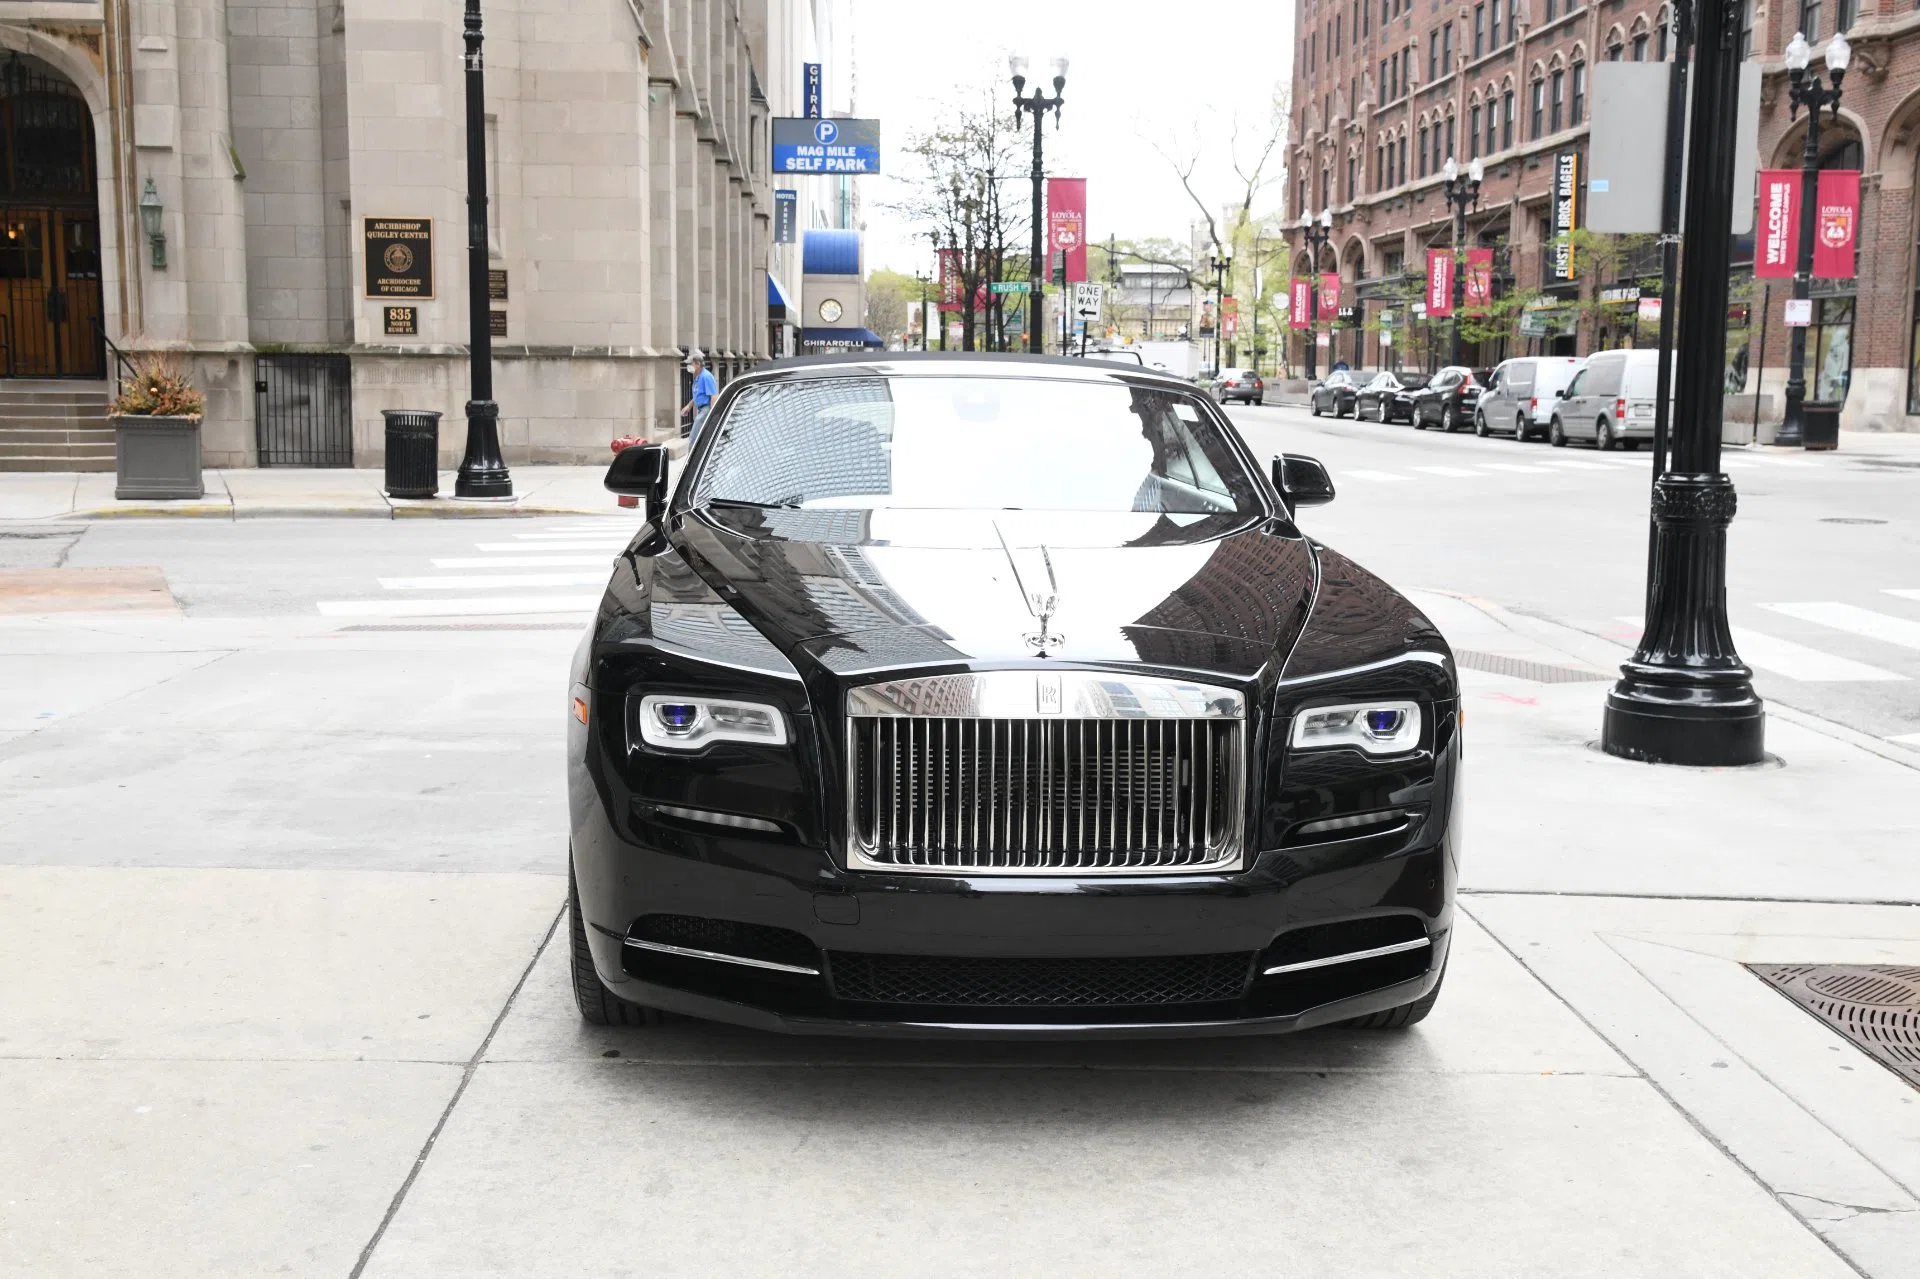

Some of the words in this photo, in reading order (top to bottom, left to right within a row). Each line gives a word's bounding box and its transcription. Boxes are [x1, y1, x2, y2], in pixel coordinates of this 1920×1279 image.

[820, 123, 834, 141] P
[796, 146, 825, 156] MAG
[827, 146, 857, 157] MILE
[785, 157, 823, 170] SELF
[825, 158, 867, 171] PARK
[1559, 155, 1574, 196] BAGELS
[1051, 211, 1082, 219] LOYOLA
[1821, 206, 1853, 214] LOYOLA
[374, 222, 421, 230] ARCHBISHOP
[1767, 182, 1783, 265] WELCOME
[367, 231, 400, 239] QUIGLEY
[400, 231, 429, 239] CENTER
[1555, 230, 1569, 278] EINSTEN
[998, 283, 1019, 292] RUSH
[1432, 256, 1443, 309] WELCOME
[1078, 286, 1099, 296] ONE
[1077, 297, 1099, 306] WAY
[389, 308, 411, 320] 835
